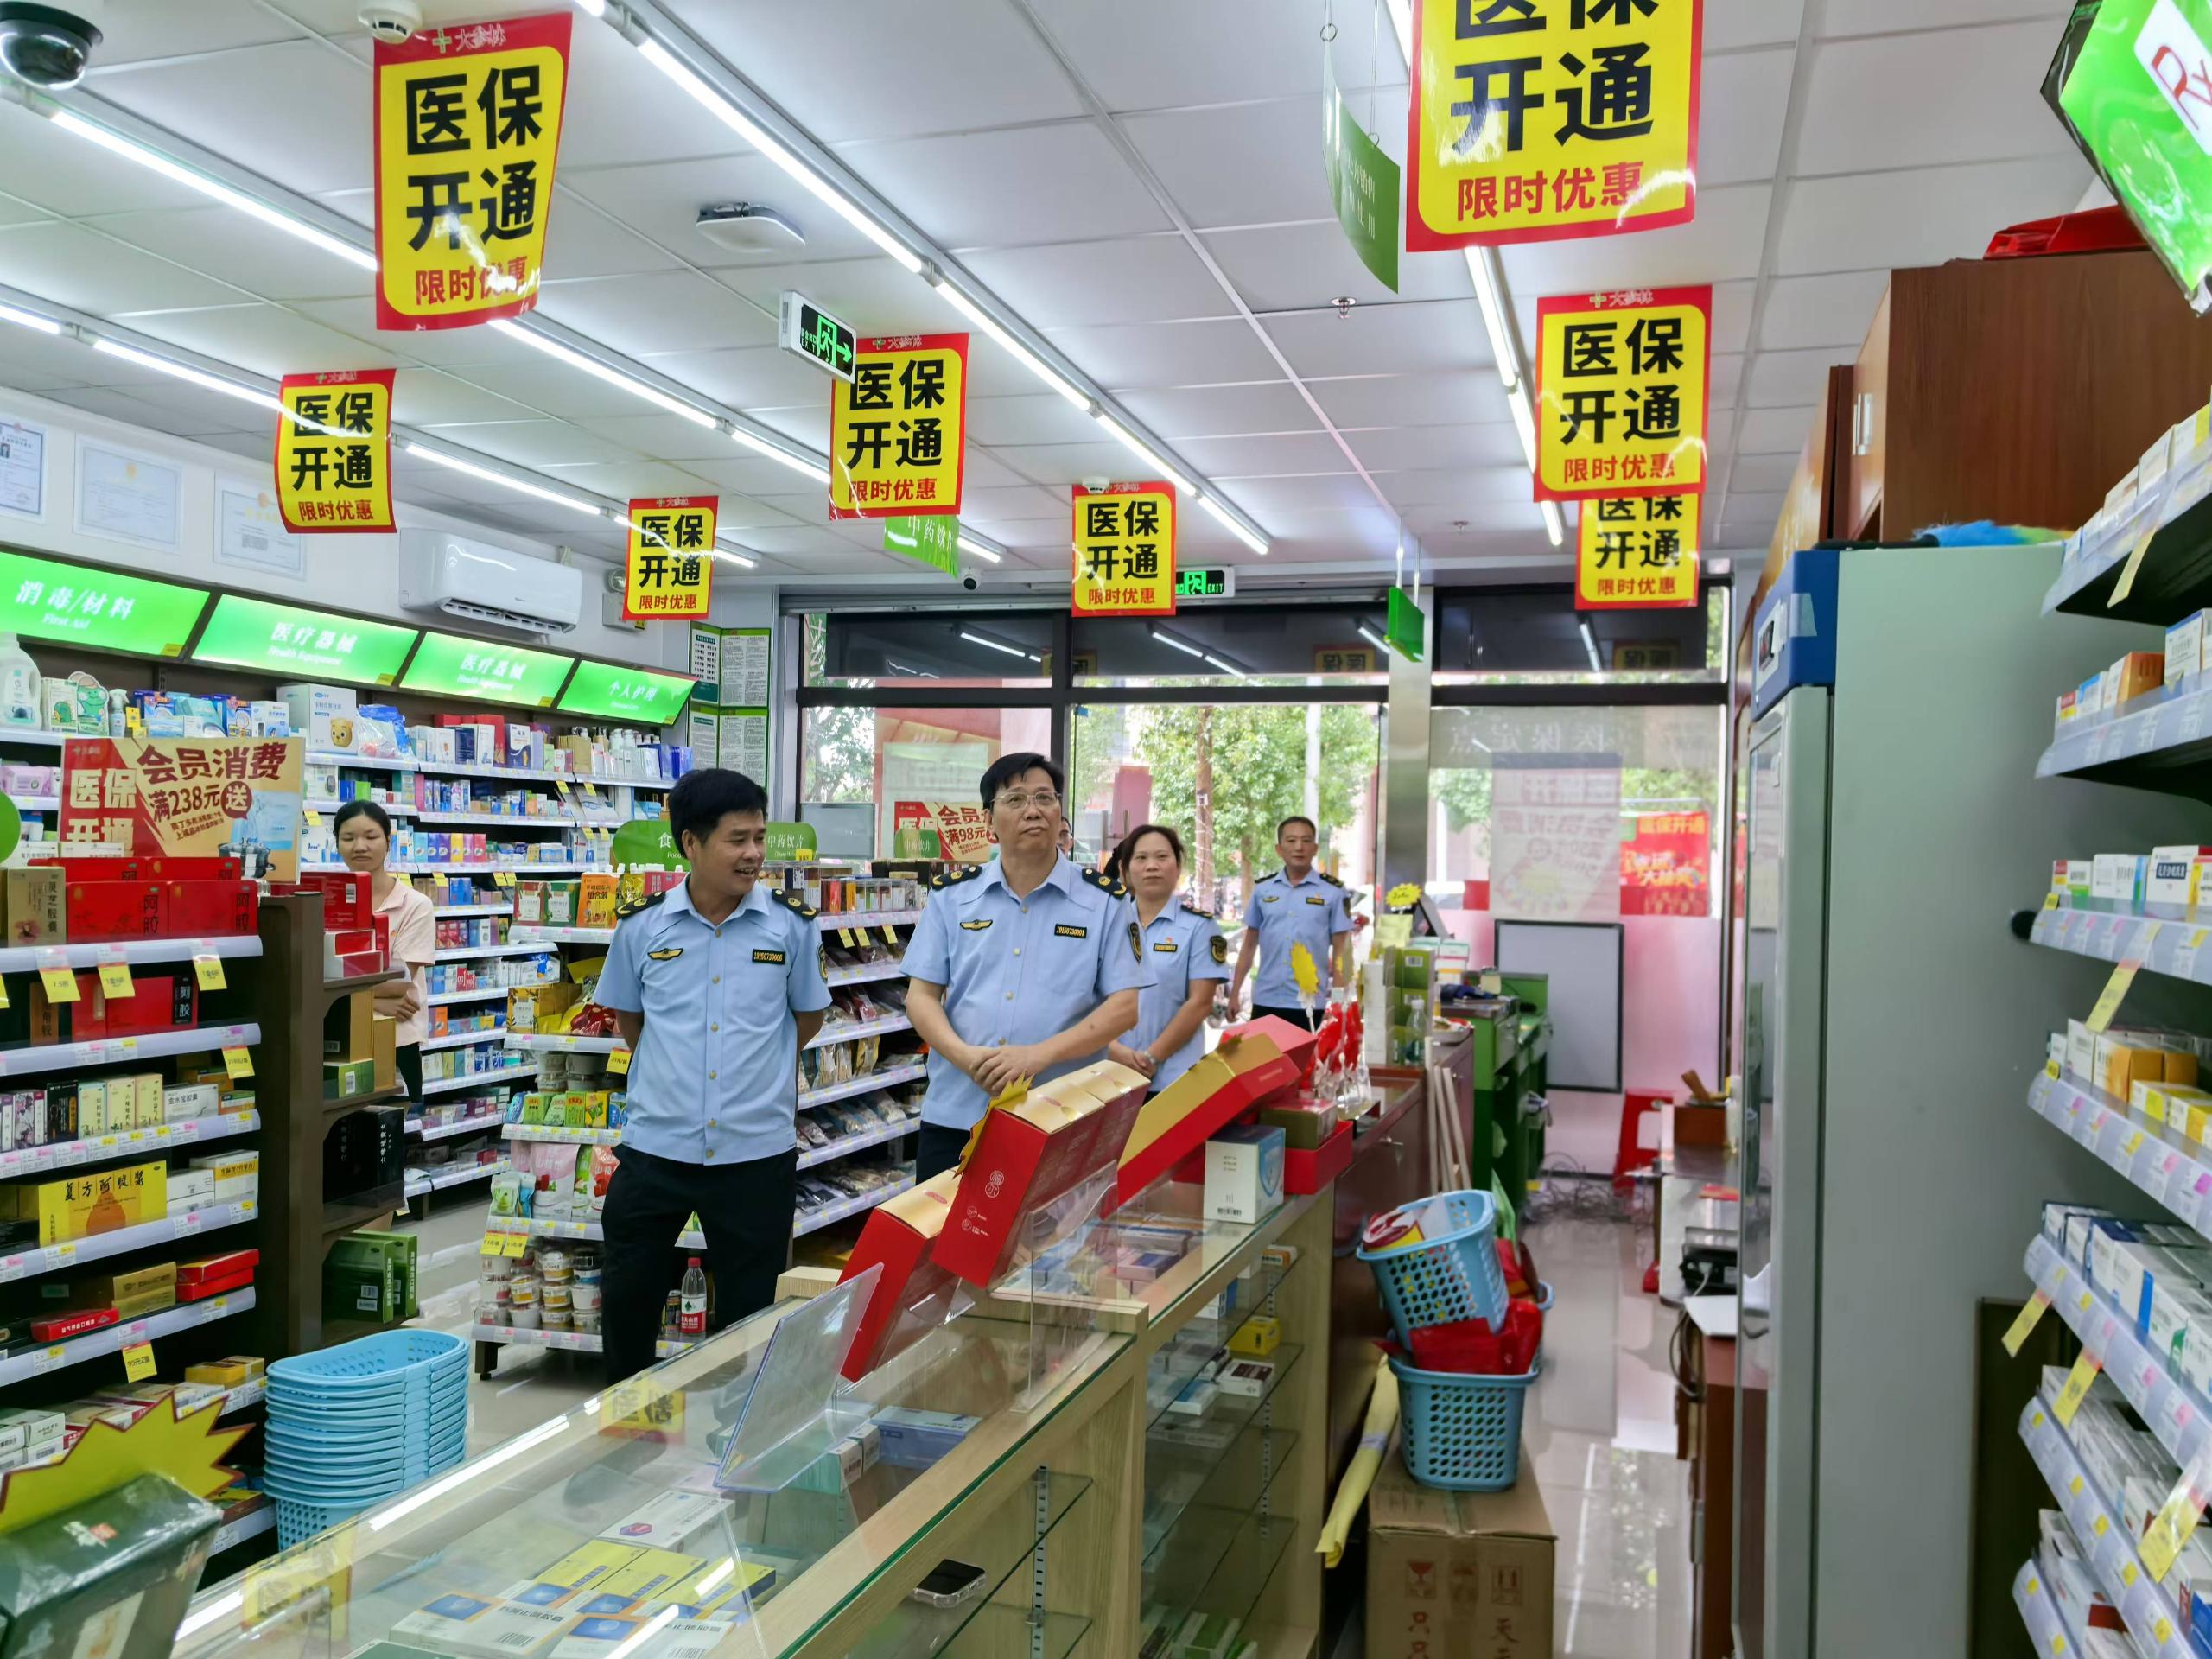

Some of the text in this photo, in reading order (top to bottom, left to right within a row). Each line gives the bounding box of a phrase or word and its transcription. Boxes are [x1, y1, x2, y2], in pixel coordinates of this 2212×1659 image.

[406, 65, 543, 155] 医保
[1451, 41, 1654, 156] 开通
[406, 160, 537, 251] 开通
[1457, 161, 1644, 222] 限时优惠
[416, 256, 528, 306] 限时优惠
[1563, 318, 1684, 378] 医保
[849, 359, 944, 410] 医保
[294, 392, 373, 437] 医保
[1560, 384, 1681, 446] 开通
[846, 418, 942, 470] 开通
[291, 444, 373, 491] 开通
[1564, 454, 1675, 484] 限时优惠
[849, 478, 938, 503] 限时优惠
[1598, 493, 1682, 521] 医保
[298, 499, 373, 521] 限时优惠
[1087, 500, 1159, 537] 医保
[641, 514, 703, 548] 医保
[1595, 529, 1680, 569] 开通
[639, 555, 701, 588] 开通
[1086, 543, 1158, 581] 开通
[639, 594, 697, 610] 限时优惠
[1089, 588, 1155, 605] 限时优惠
[1207, 583, 1224, 594] EXIT
[1597, 577, 1676, 595] 限时优惠
[270, 621, 358, 654] 医疗器械
[460, 653, 527, 681] 医疗器械
[608, 679, 658, 702] 个人护理
[137, 741, 288, 785] 会员消费
[69, 767, 137, 809] 医保
[148, 783, 248, 823] 满238元 送
[938, 805, 988, 826] 会员
[767, 831, 803, 849] 中药饮片
[945, 826, 986, 846] 满98元
[48, 880, 58, 934] 灵芝胶囊
[143, 894, 159, 934] 阿胶
[235, 893, 250, 933] 阿胶
[180, 986, 191, 1017] 阿胶
[168, 1092, 199, 1106] 金水宝胶囊
[65, 1169, 145, 1202] 复方阿胶浆
